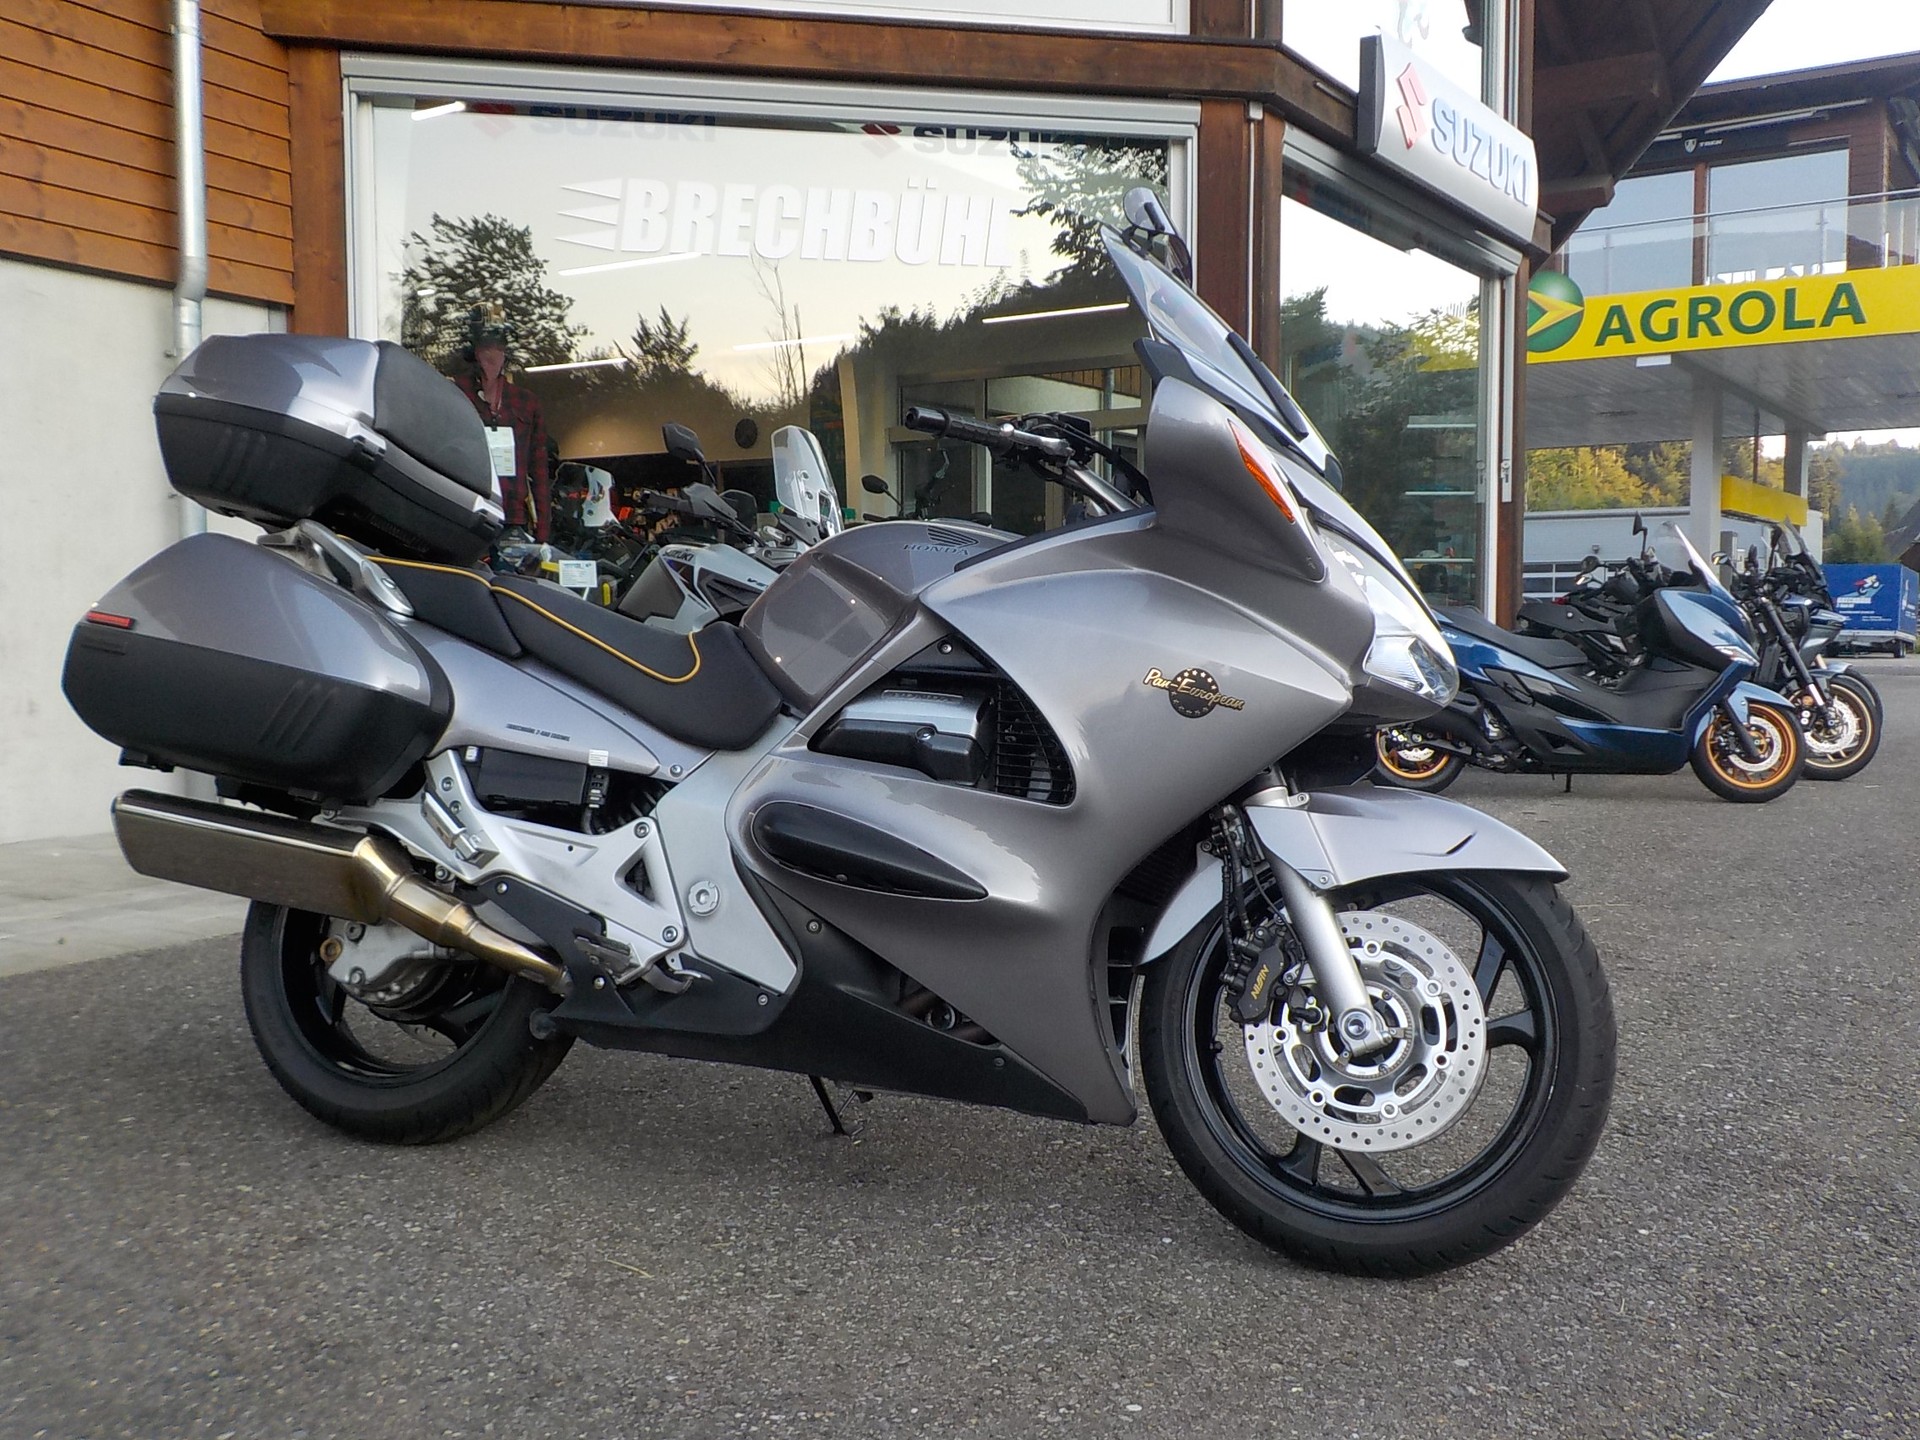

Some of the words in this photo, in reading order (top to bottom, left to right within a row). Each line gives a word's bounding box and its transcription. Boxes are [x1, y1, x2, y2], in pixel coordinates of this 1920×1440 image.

[529, 105, 716, 142] SUZUKI
[1430, 97, 1531, 208] SUZUKI
[1595, 282, 1867, 347] AGROLA
[903, 543, 969, 555] HONDA
[1143, 667, 1245, 710] Pan-European
